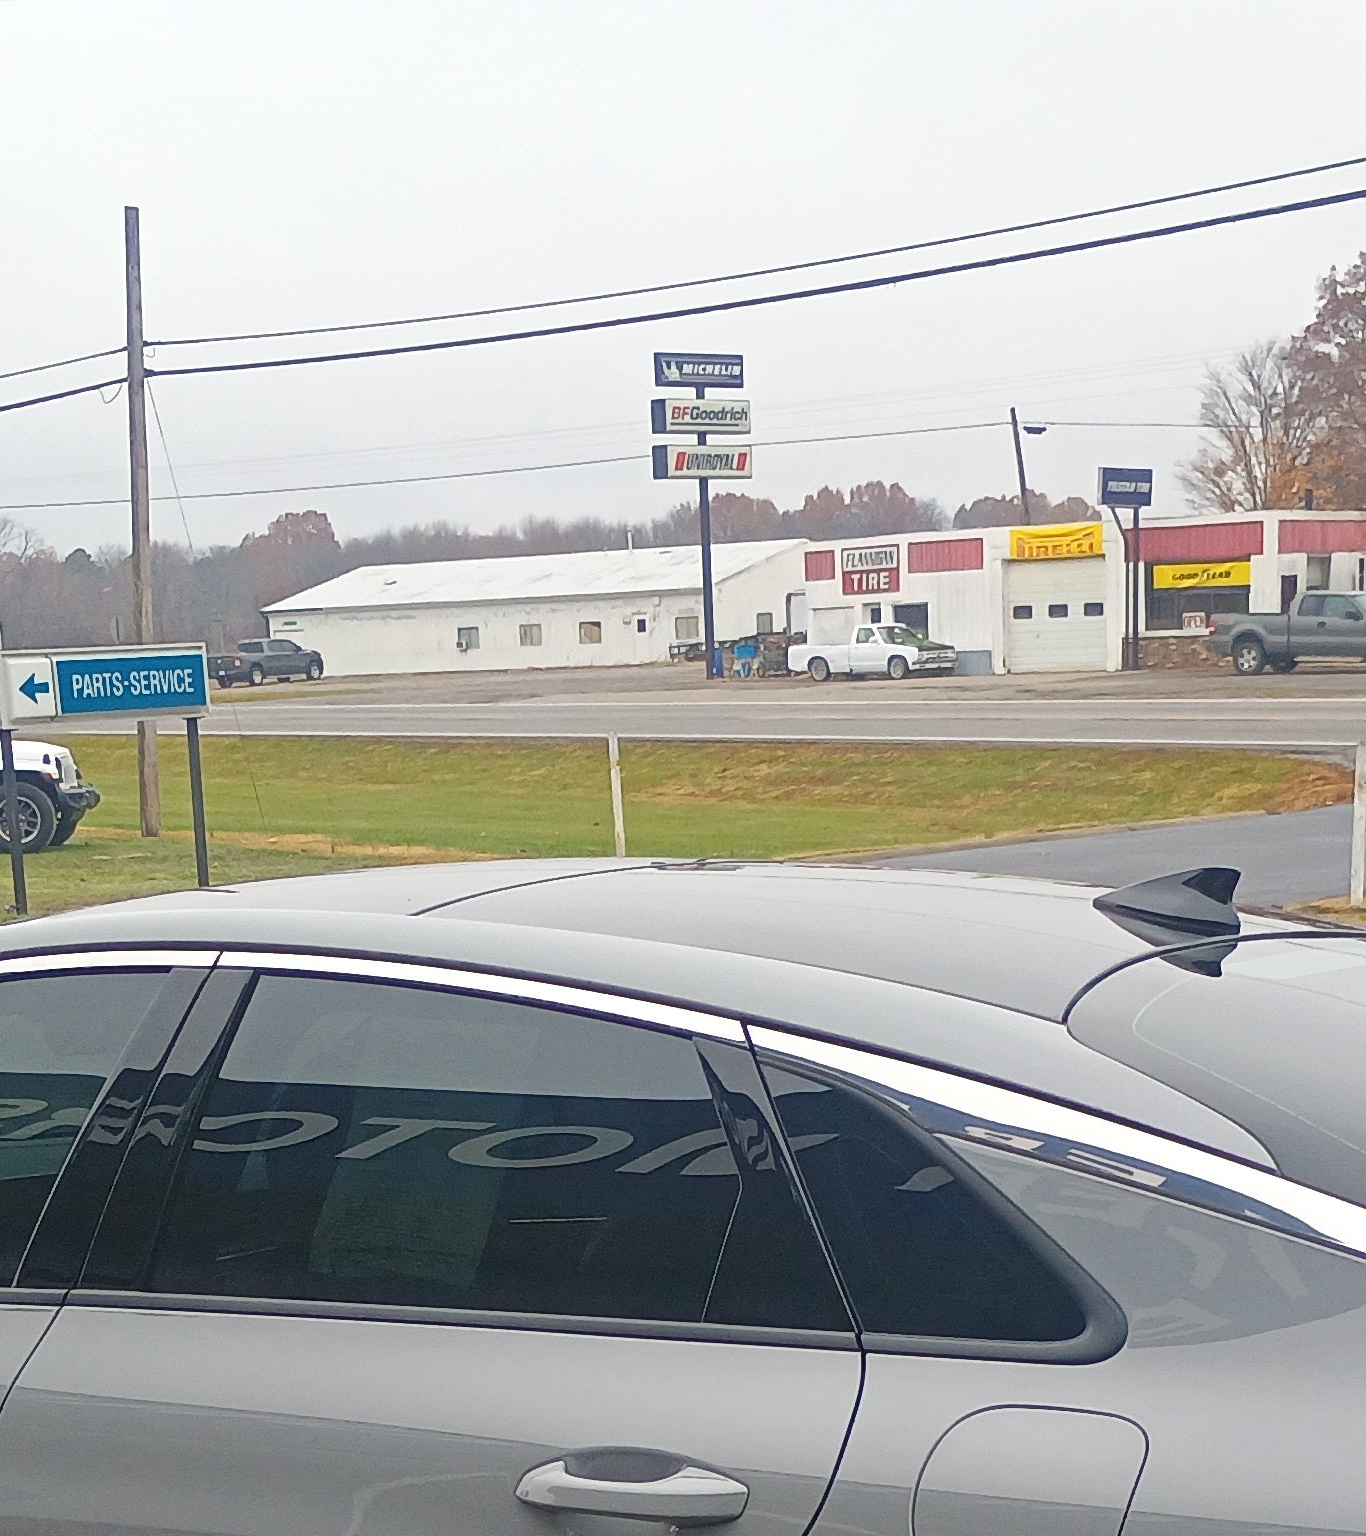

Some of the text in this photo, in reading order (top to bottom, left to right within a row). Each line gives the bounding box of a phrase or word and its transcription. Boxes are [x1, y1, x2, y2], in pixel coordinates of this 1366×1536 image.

[681, 363, 741, 377] MICHELIN
[671, 405, 748, 422] BFGoodrich
[850, 571, 890, 592] TIRE
[72, 668, 195, 699] PARTS-SERVICE
